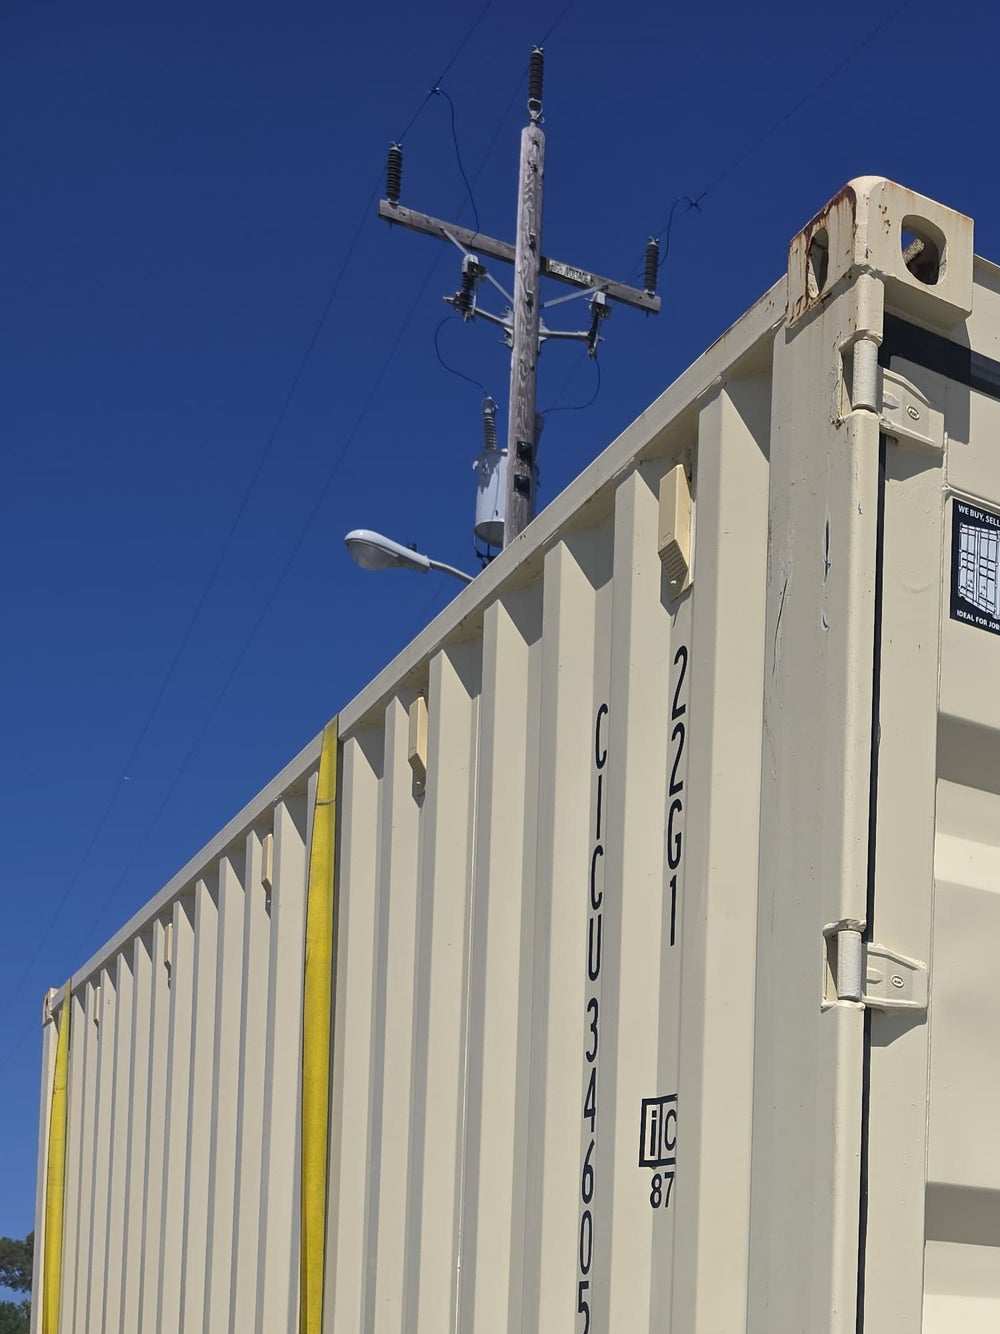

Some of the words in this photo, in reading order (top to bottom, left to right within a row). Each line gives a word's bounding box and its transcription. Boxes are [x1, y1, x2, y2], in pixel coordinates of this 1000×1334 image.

[958, 504, 969, 515] WE
[970, 509, 985, 522] BUY,
[956, 609, 975, 622] IDEAL
[975, 616, 988, 626] FOR
[668, 645, 688, 947] 22G1
[589, 703, 609, 982] CICU
[649, 1171, 675, 1209] 87
